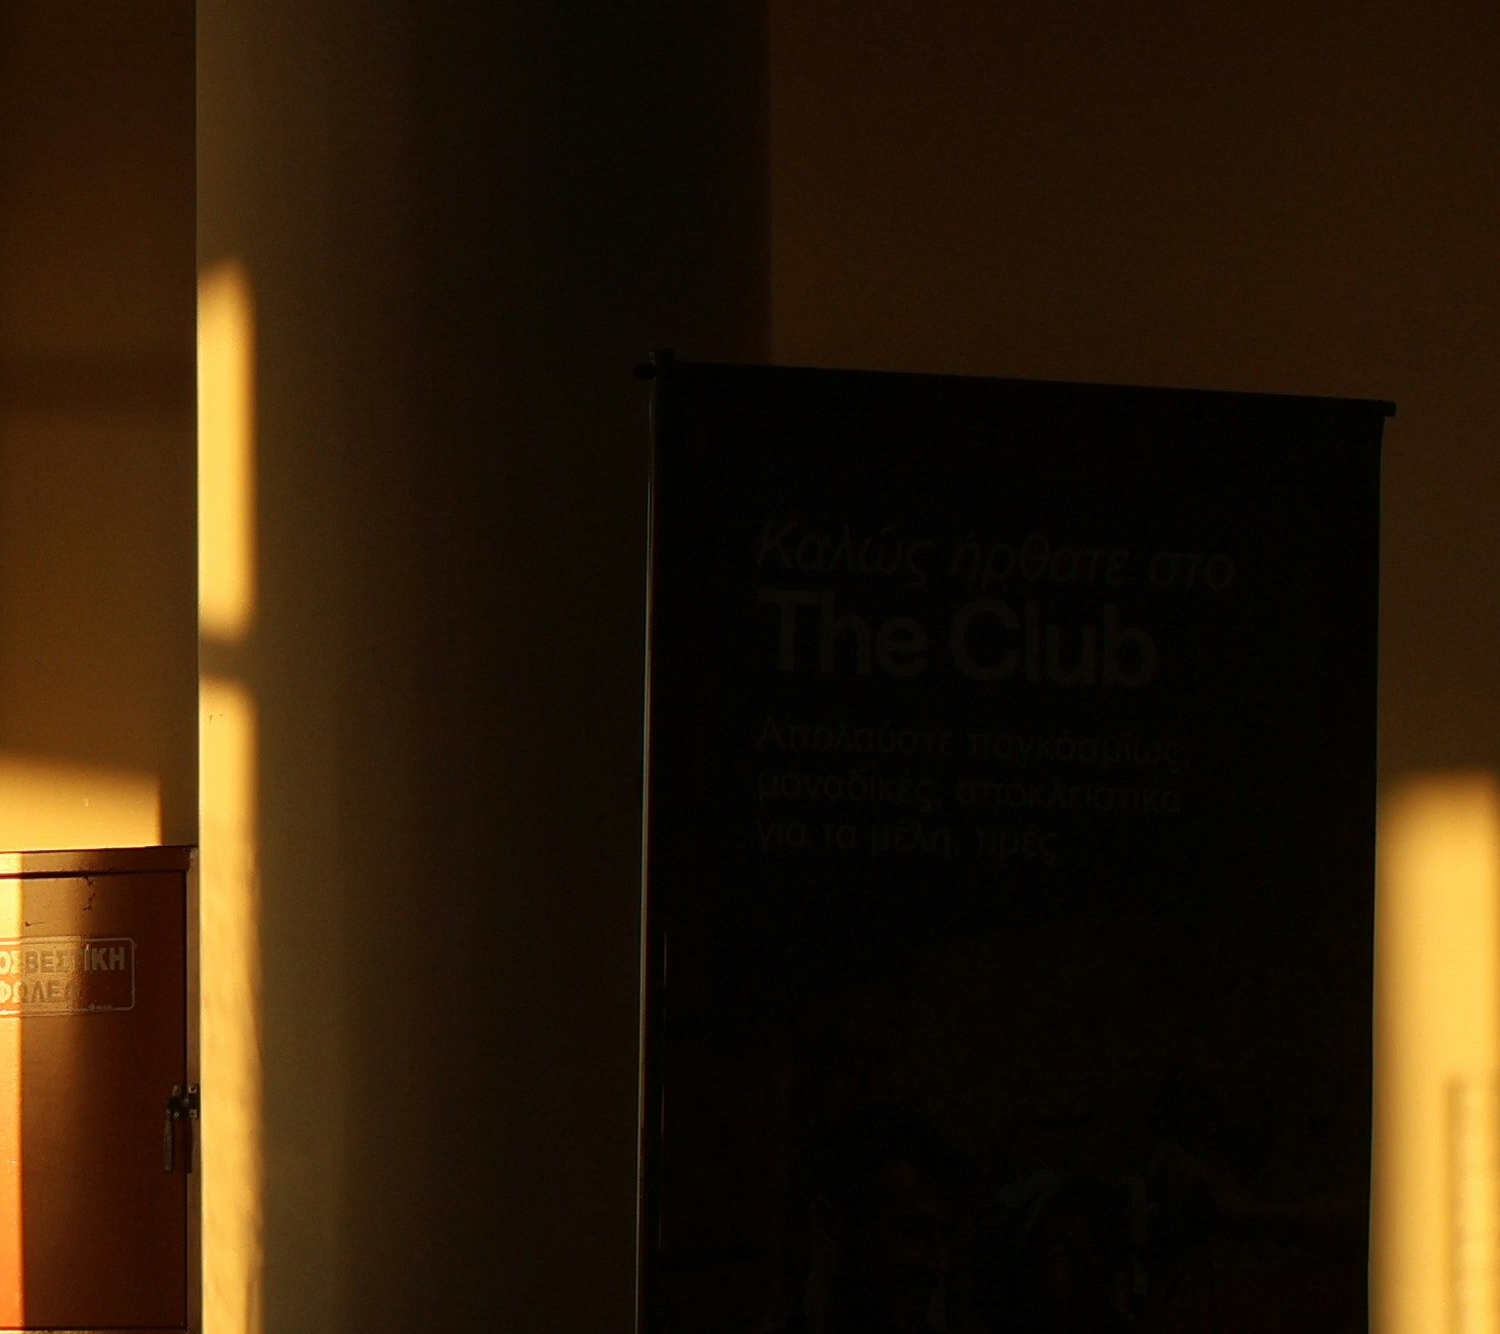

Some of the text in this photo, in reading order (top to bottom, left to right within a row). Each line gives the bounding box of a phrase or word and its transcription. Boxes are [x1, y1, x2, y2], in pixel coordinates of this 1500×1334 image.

[1147, 549, 1237, 591] στο
[756, 588, 1158, 689] The Club
[755, 818, 808, 852] για
[821, 823, 857, 850] τα
